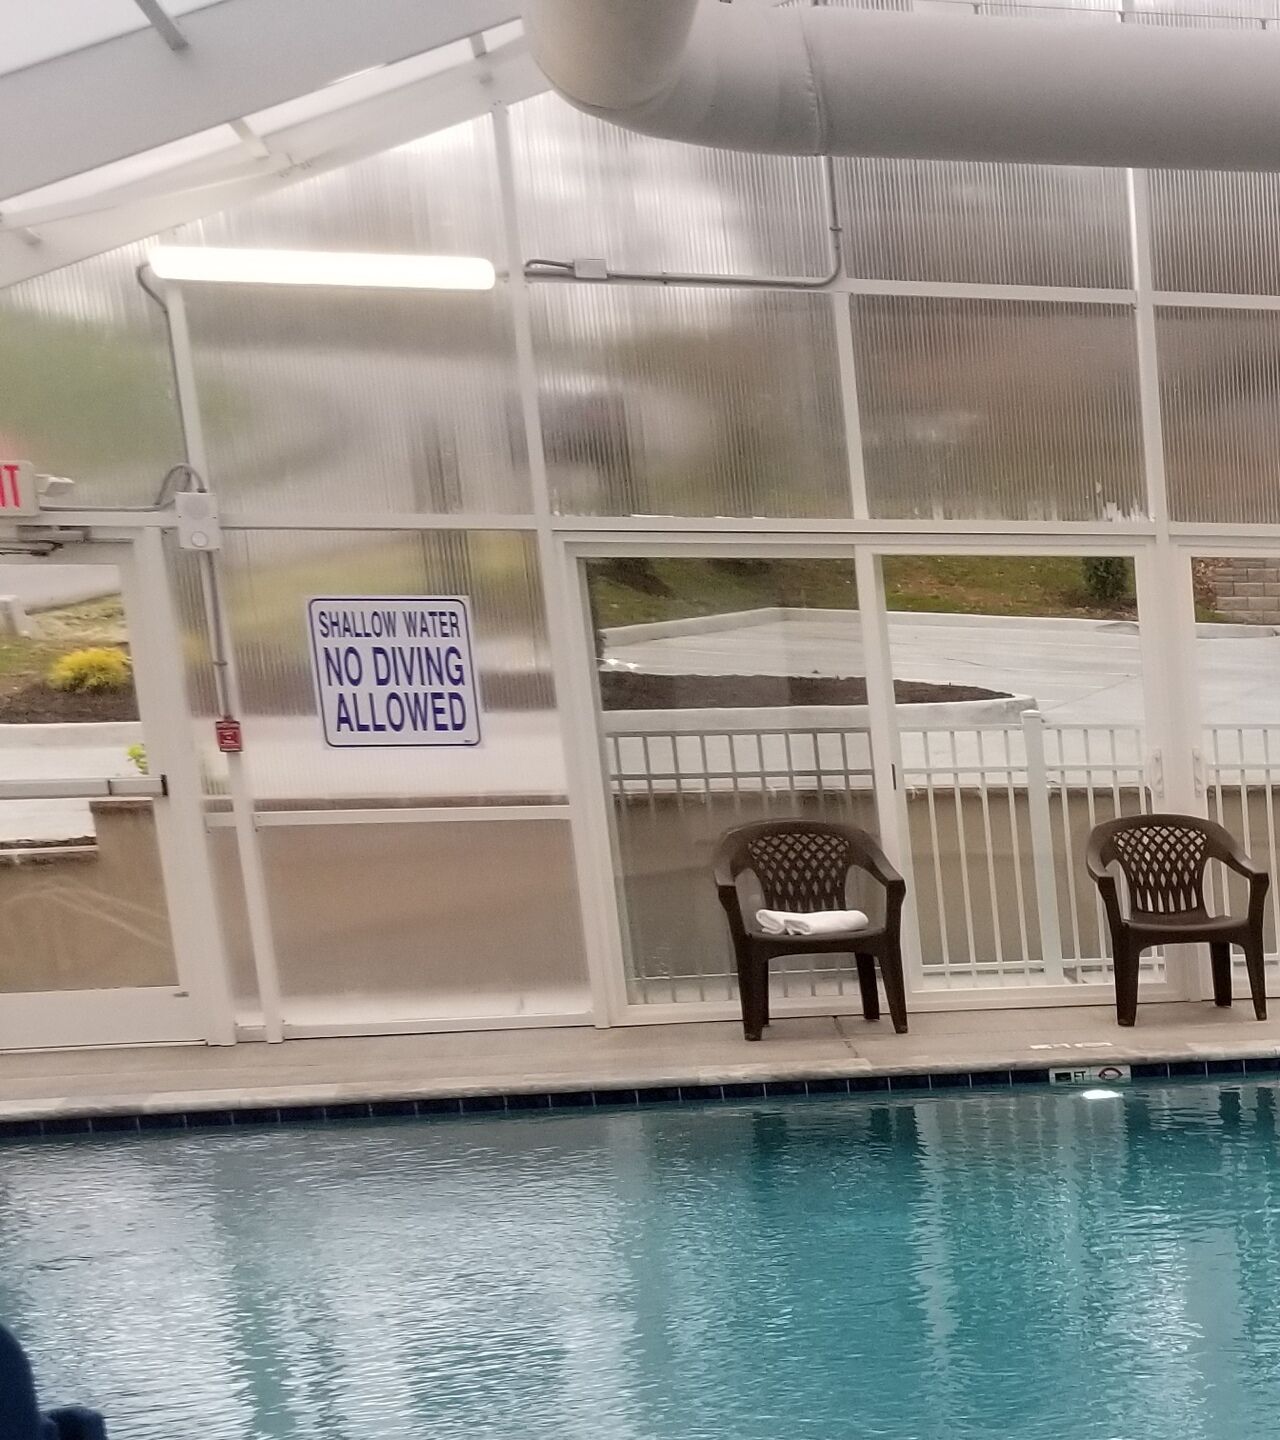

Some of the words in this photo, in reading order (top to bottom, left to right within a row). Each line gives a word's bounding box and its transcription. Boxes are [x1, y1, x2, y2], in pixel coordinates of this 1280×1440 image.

[318, 610, 397, 638] SHALLOW
[402, 610, 461, 638] WATER
[323, 646, 363, 687] NO
[371, 646, 465, 687] DIVING
[336, 692, 467, 732] ALLOWED
